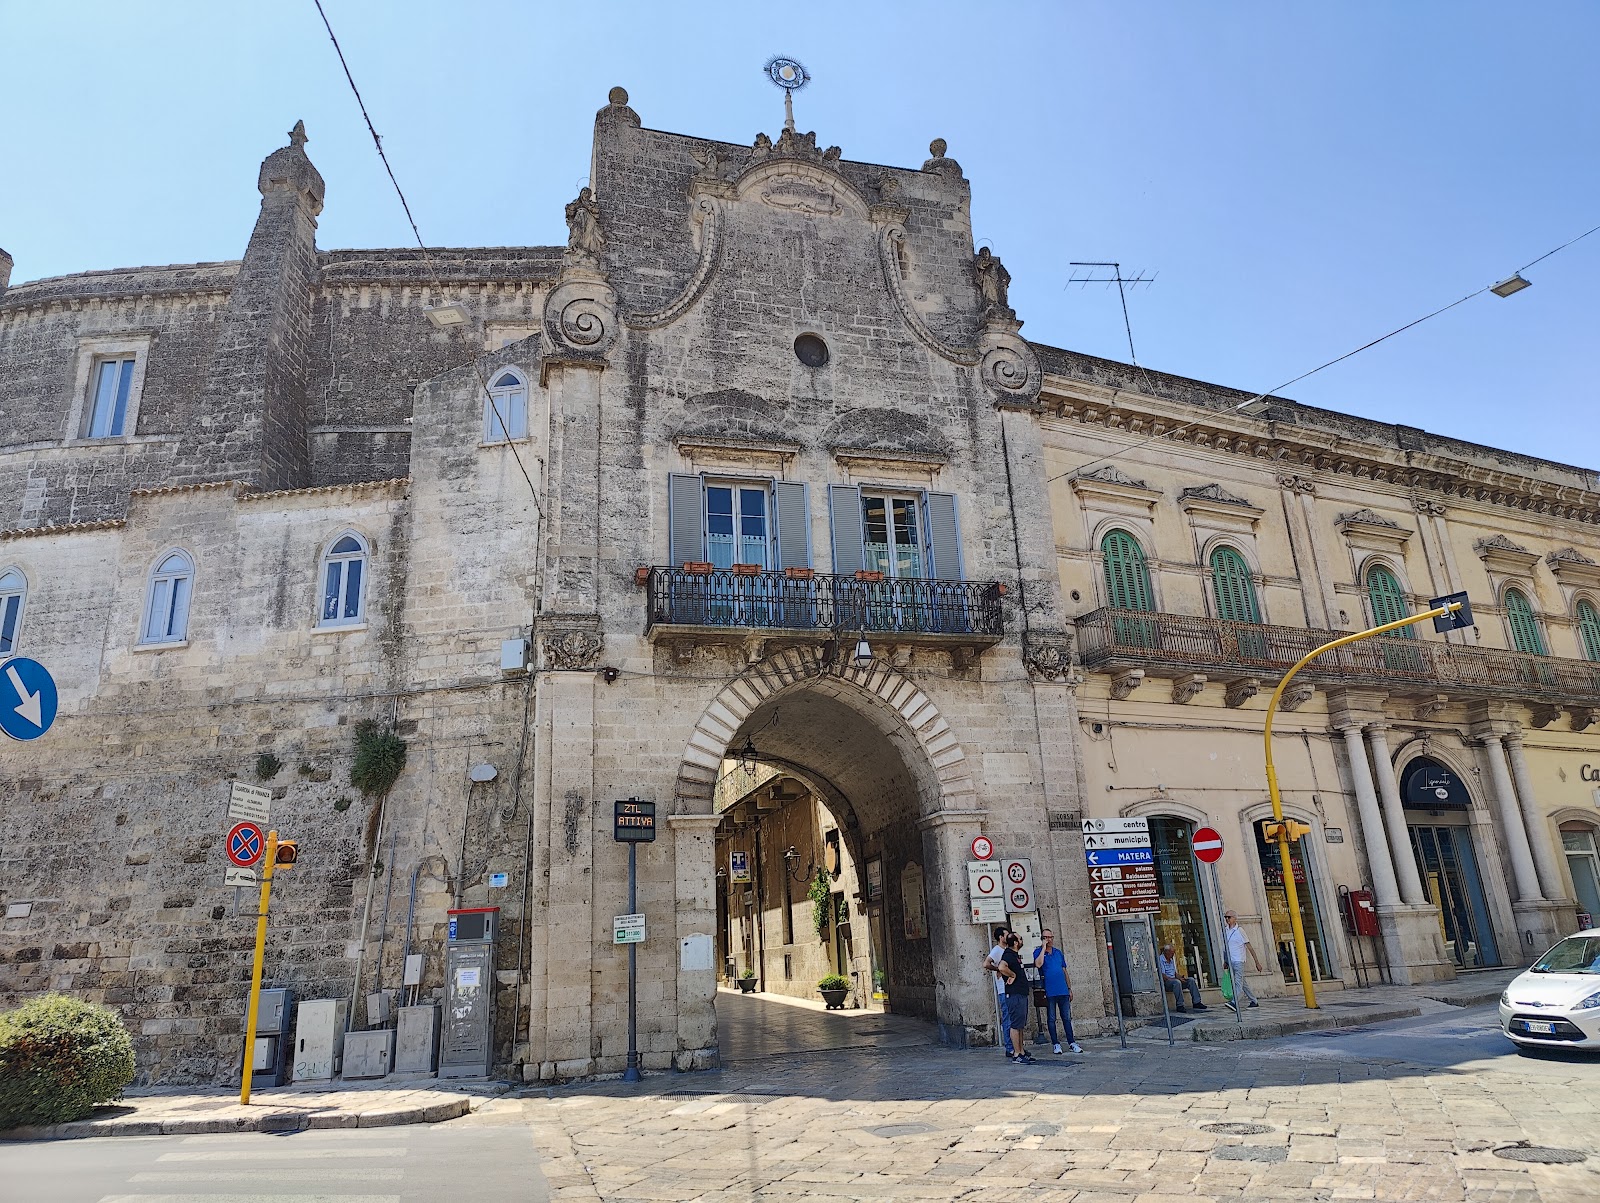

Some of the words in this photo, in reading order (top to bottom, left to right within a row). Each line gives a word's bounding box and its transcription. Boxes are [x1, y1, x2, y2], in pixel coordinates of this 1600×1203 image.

[235, 785, 250, 794] GUARDIA
[255, 790, 270, 798] FINANZA
[624, 804, 641, 813] ZTL
[618, 816, 652, 826] ATTIVA
[1114, 835, 1148, 844] municipio
[1118, 852, 1151, 860] MATERA
[1012, 869, 1017, 877] 2
